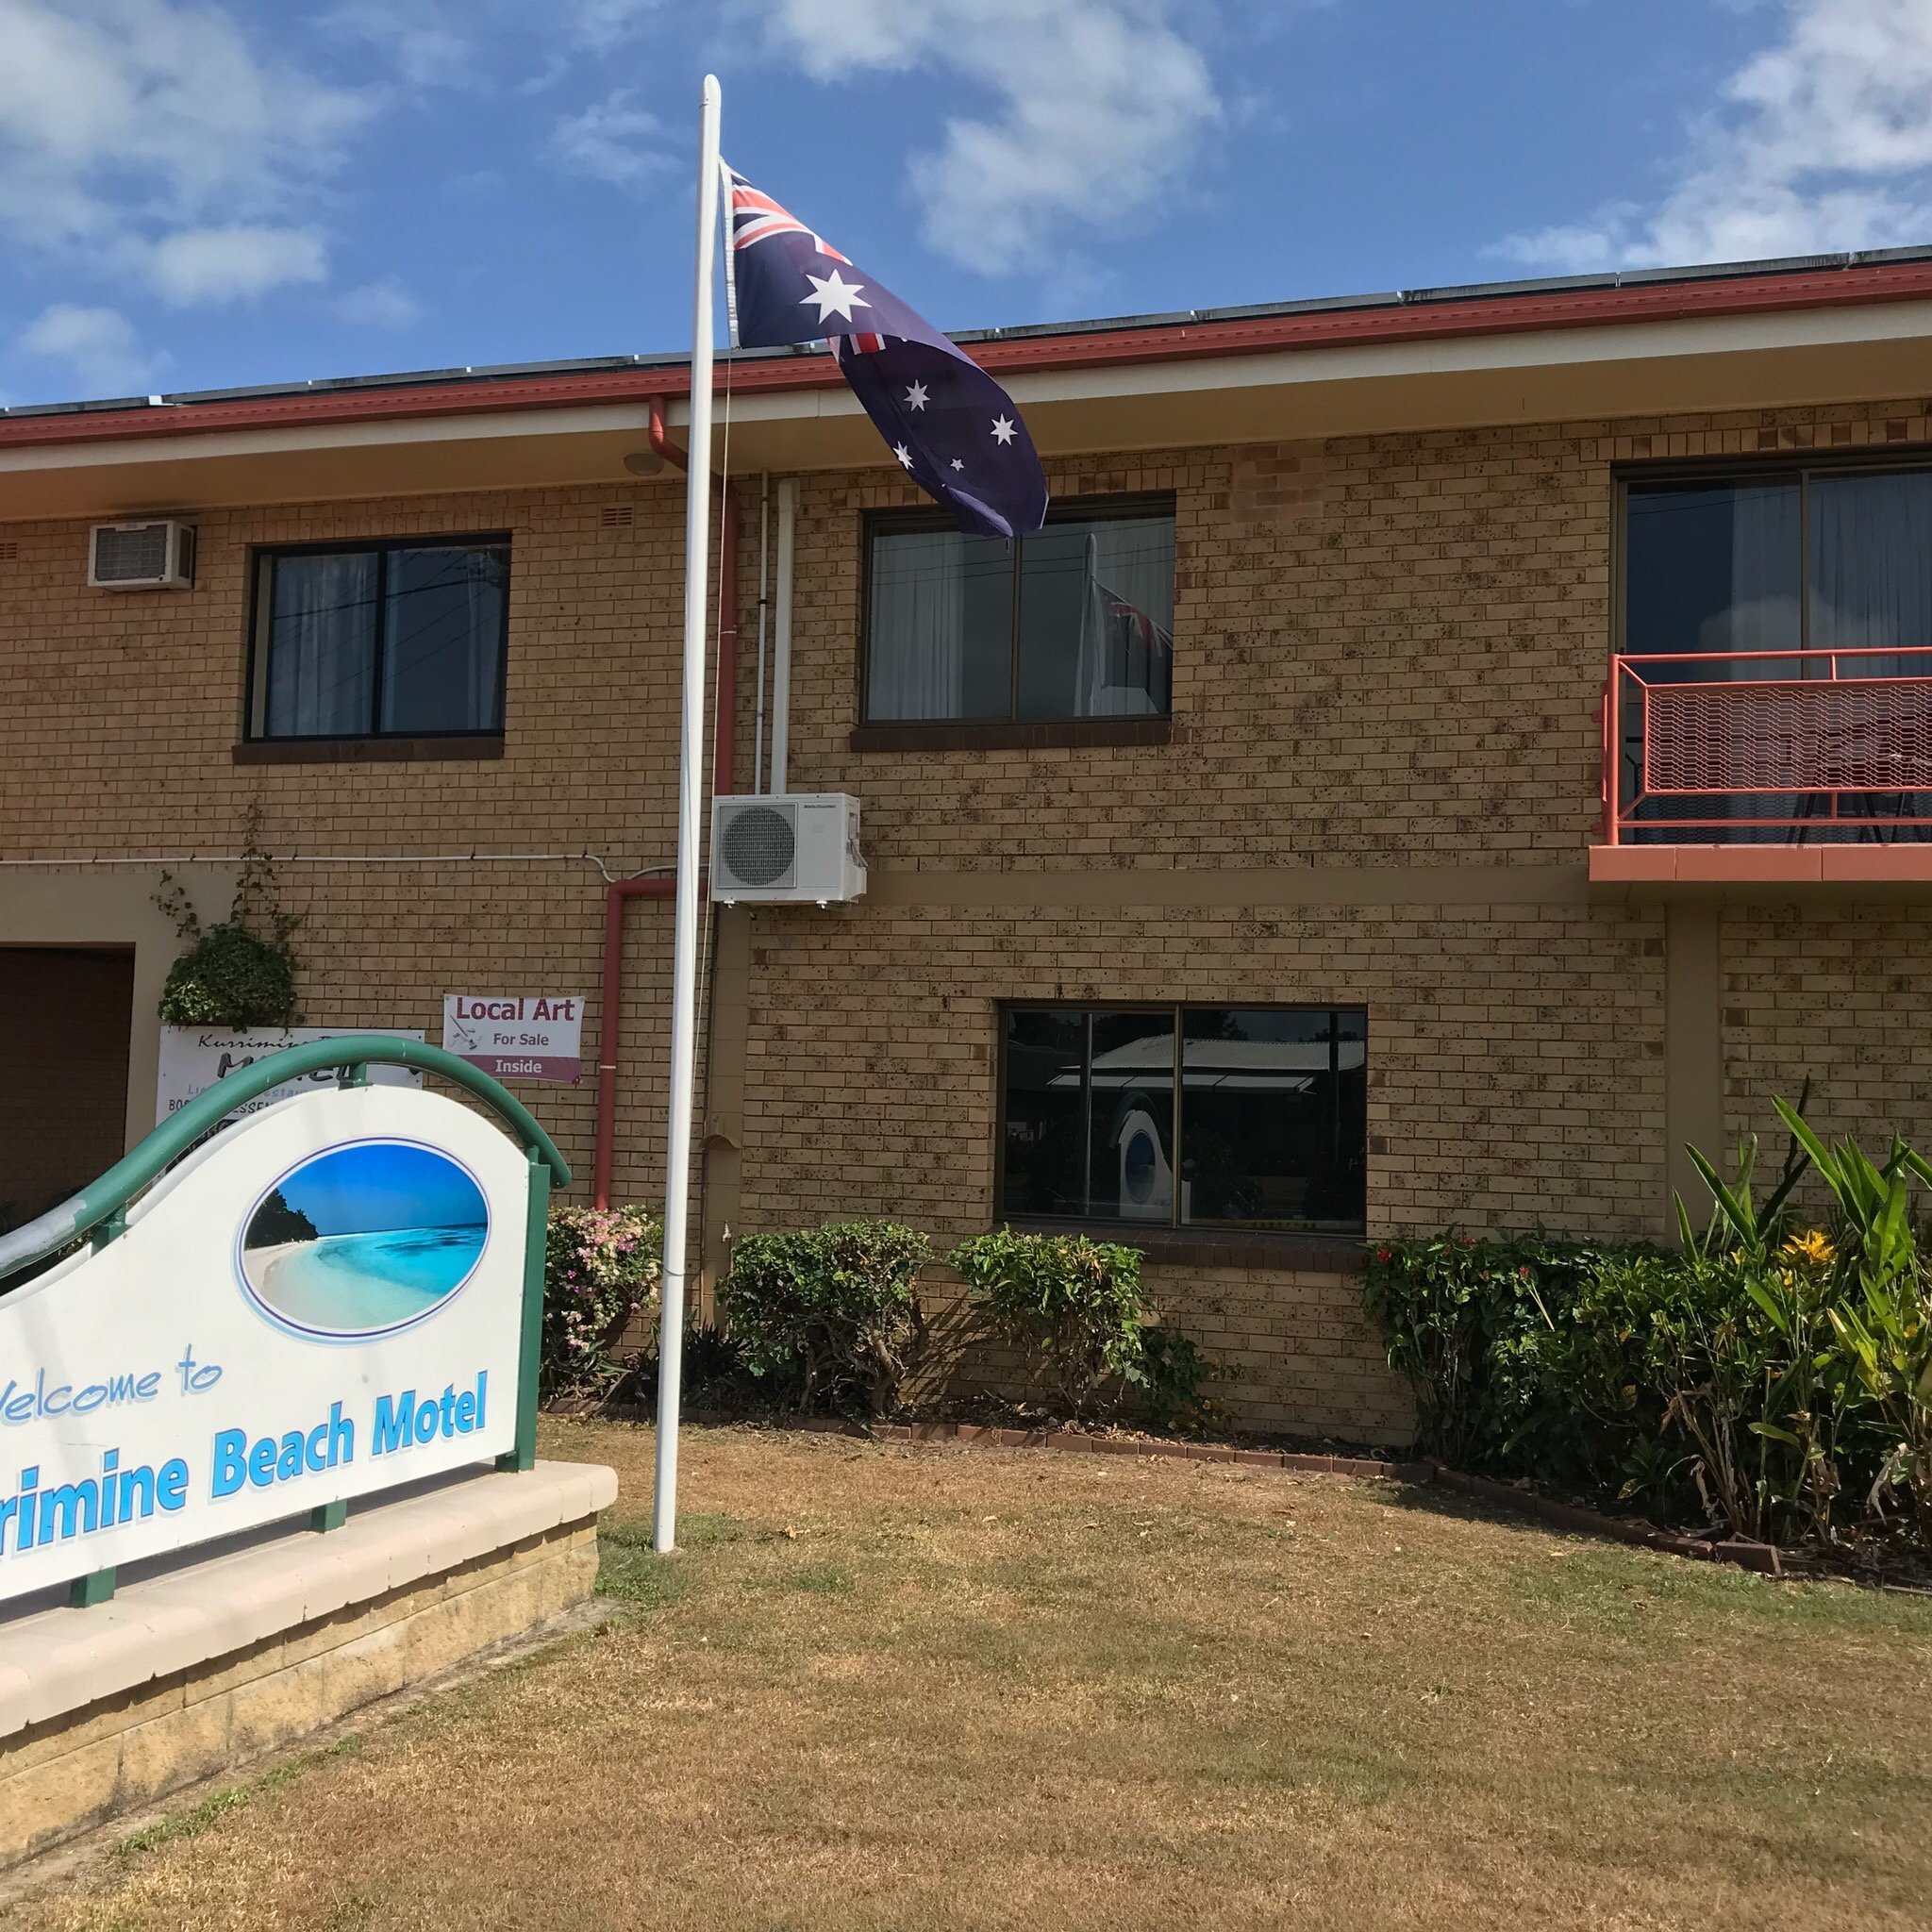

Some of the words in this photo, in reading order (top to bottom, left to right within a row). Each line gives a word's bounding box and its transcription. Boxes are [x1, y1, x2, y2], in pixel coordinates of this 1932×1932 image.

[456, 996, 525, 1021] Local
[532, 998, 575, 1021] Art
[493, 1033, 516, 1044] For
[519, 1033, 549, 1045] Sale
[495, 1058, 542, 1074] Inside
[177, 1343, 223, 1391] to
[211, 1401, 355, 1500] Beach
[372, 1370, 488, 1457] Motel
